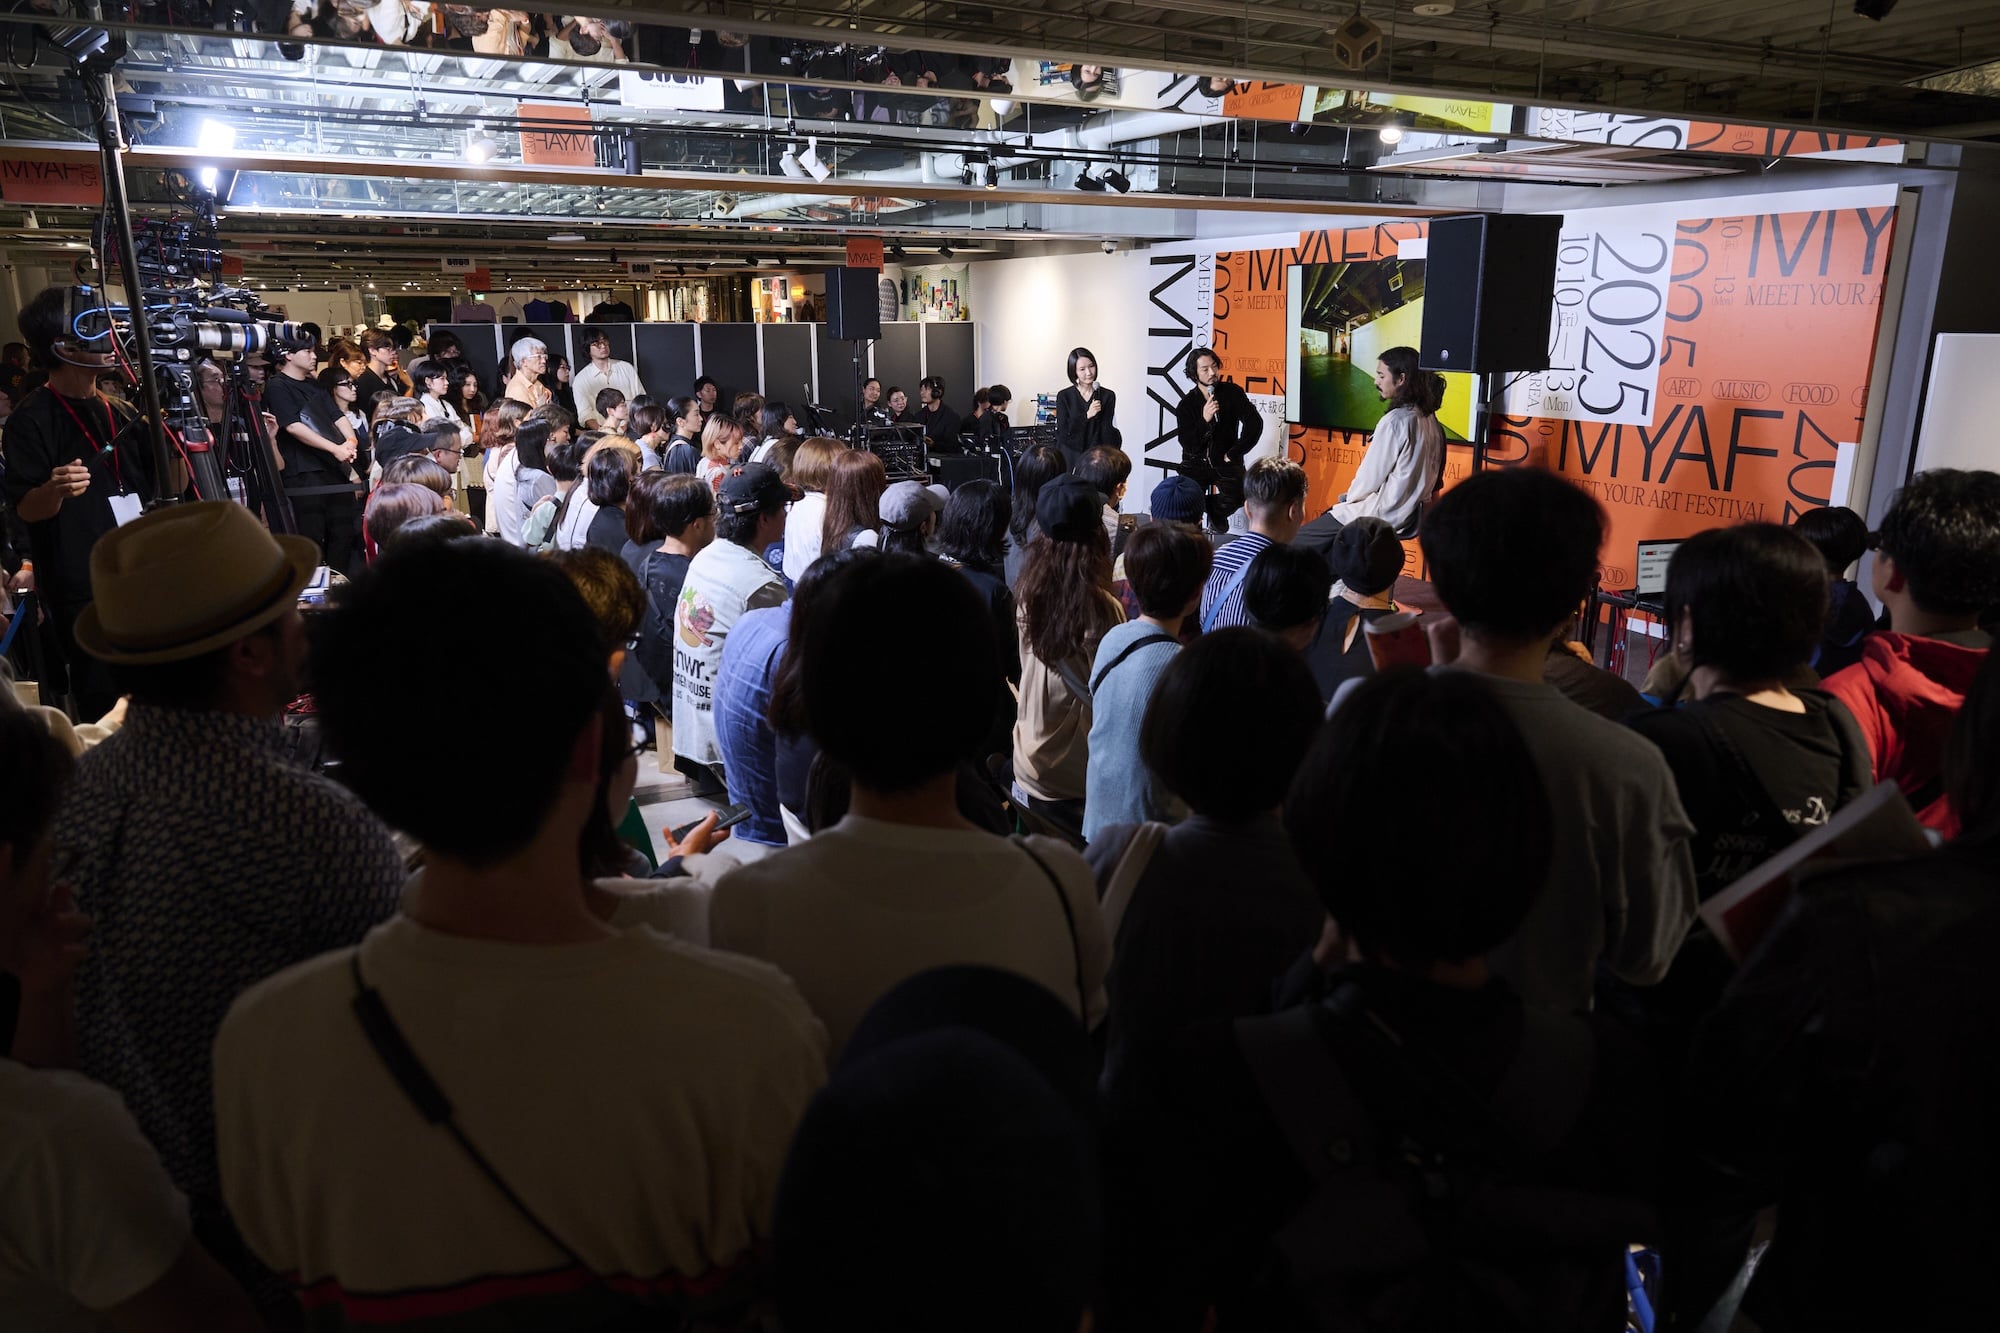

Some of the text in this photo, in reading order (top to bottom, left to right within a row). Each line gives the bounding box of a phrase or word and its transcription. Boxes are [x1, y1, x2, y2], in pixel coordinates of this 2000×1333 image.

[1557, 232, 1590, 307] 10.10
[1197, 254, 1212, 316] MEET
[1743, 283, 1804, 306] MEET
[1808, 282, 1866, 305] YOUR
[1247, 295, 1272, 310] MEET
[1555, 311, 1580, 328] (Fri)
[1577, 231, 1669, 417] 2025
[1545, 363, 1577, 392] 13
[1668, 380, 1695, 396] ART
[1718, 381, 1766, 400] MUSIC
[1790, 384, 1834, 404] FOOD
[1542, 395, 1574, 412] (Mon)
[1326, 447, 1355, 465] MEET
[1559, 403, 1785, 492] MYAF
[1602, 482, 1646, 507] YOUR
[1647, 488, 1683, 511] ART
[1685, 493, 1770, 523] FESTIVAL
